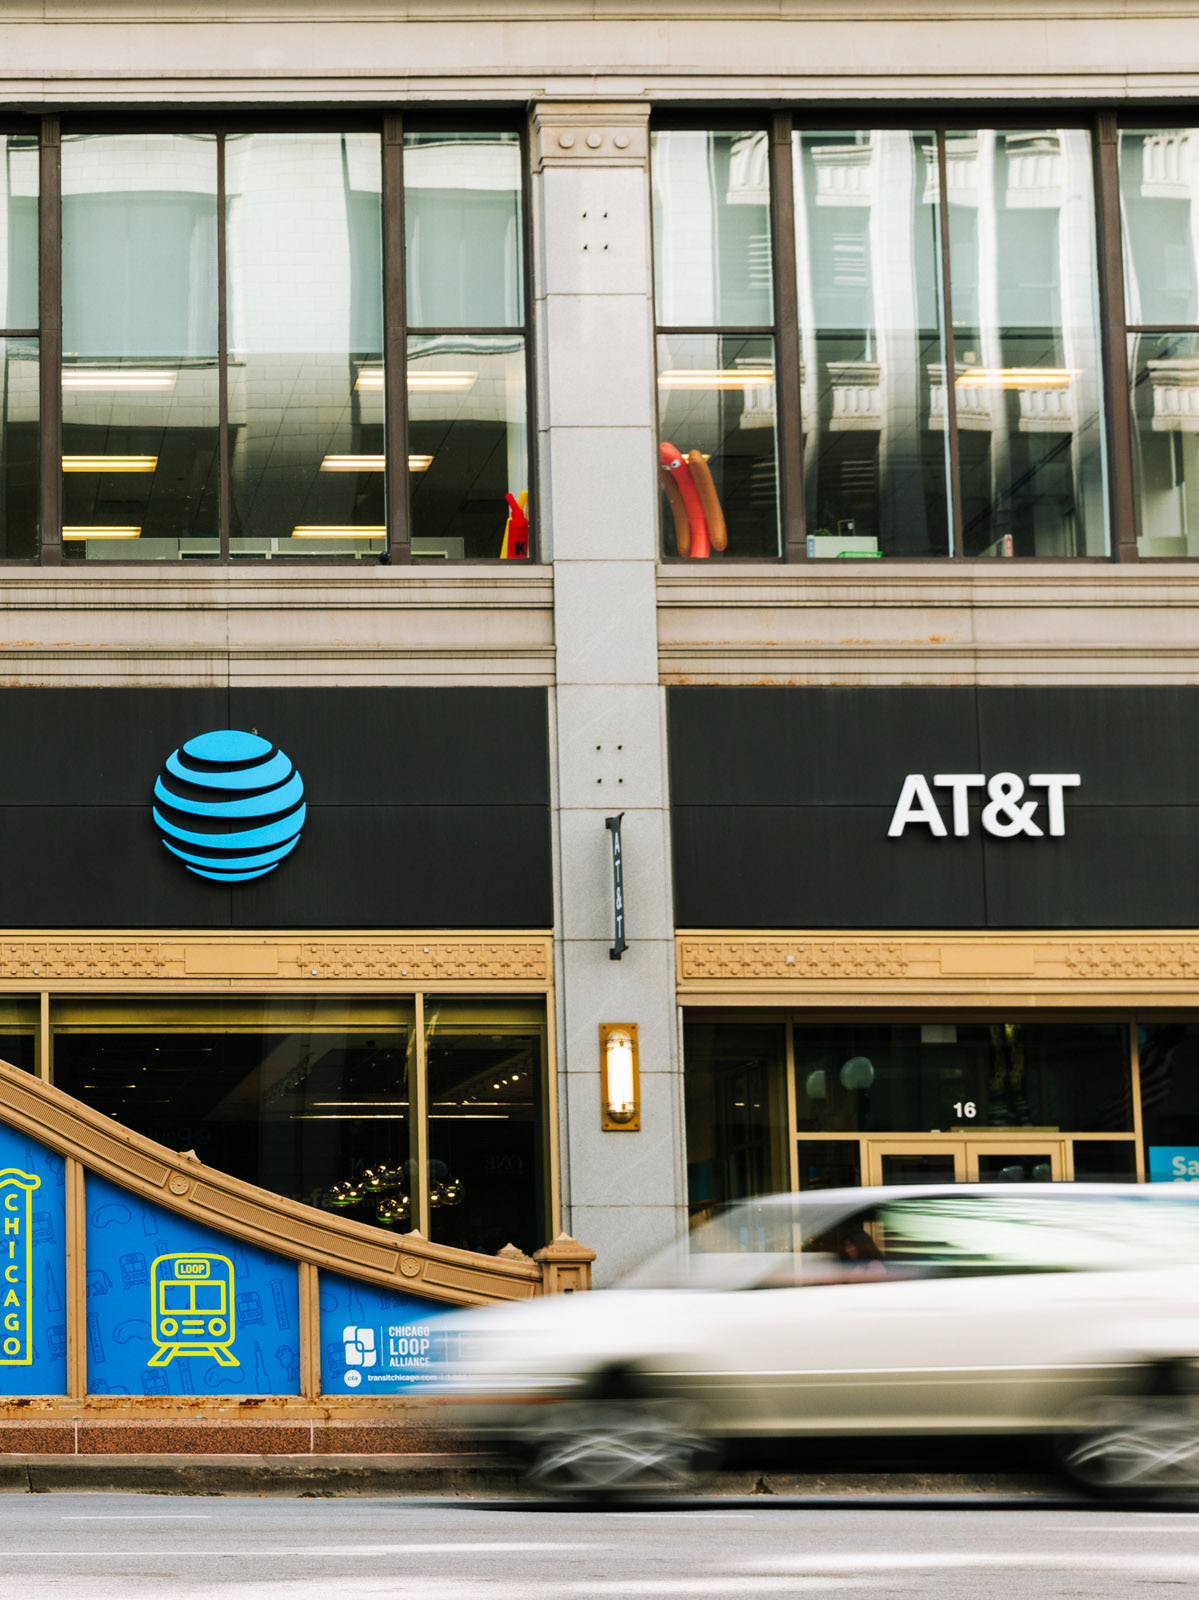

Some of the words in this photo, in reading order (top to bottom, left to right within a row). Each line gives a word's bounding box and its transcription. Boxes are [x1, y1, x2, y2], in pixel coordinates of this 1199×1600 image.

[887, 772, 1081, 837] AT&T
[953, 1101, 977, 1118] 16
[3, 1193, 21, 1355] CHICAGO
[180, 1264, 205, 1273] LOOP
[388, 1325, 431, 1337] CHICAGO
[388, 1338, 431, 1356] LOOP
[388, 1357, 431, 1367] ALLIANCE
[367, 1374, 438, 1383] transitchicago.com
